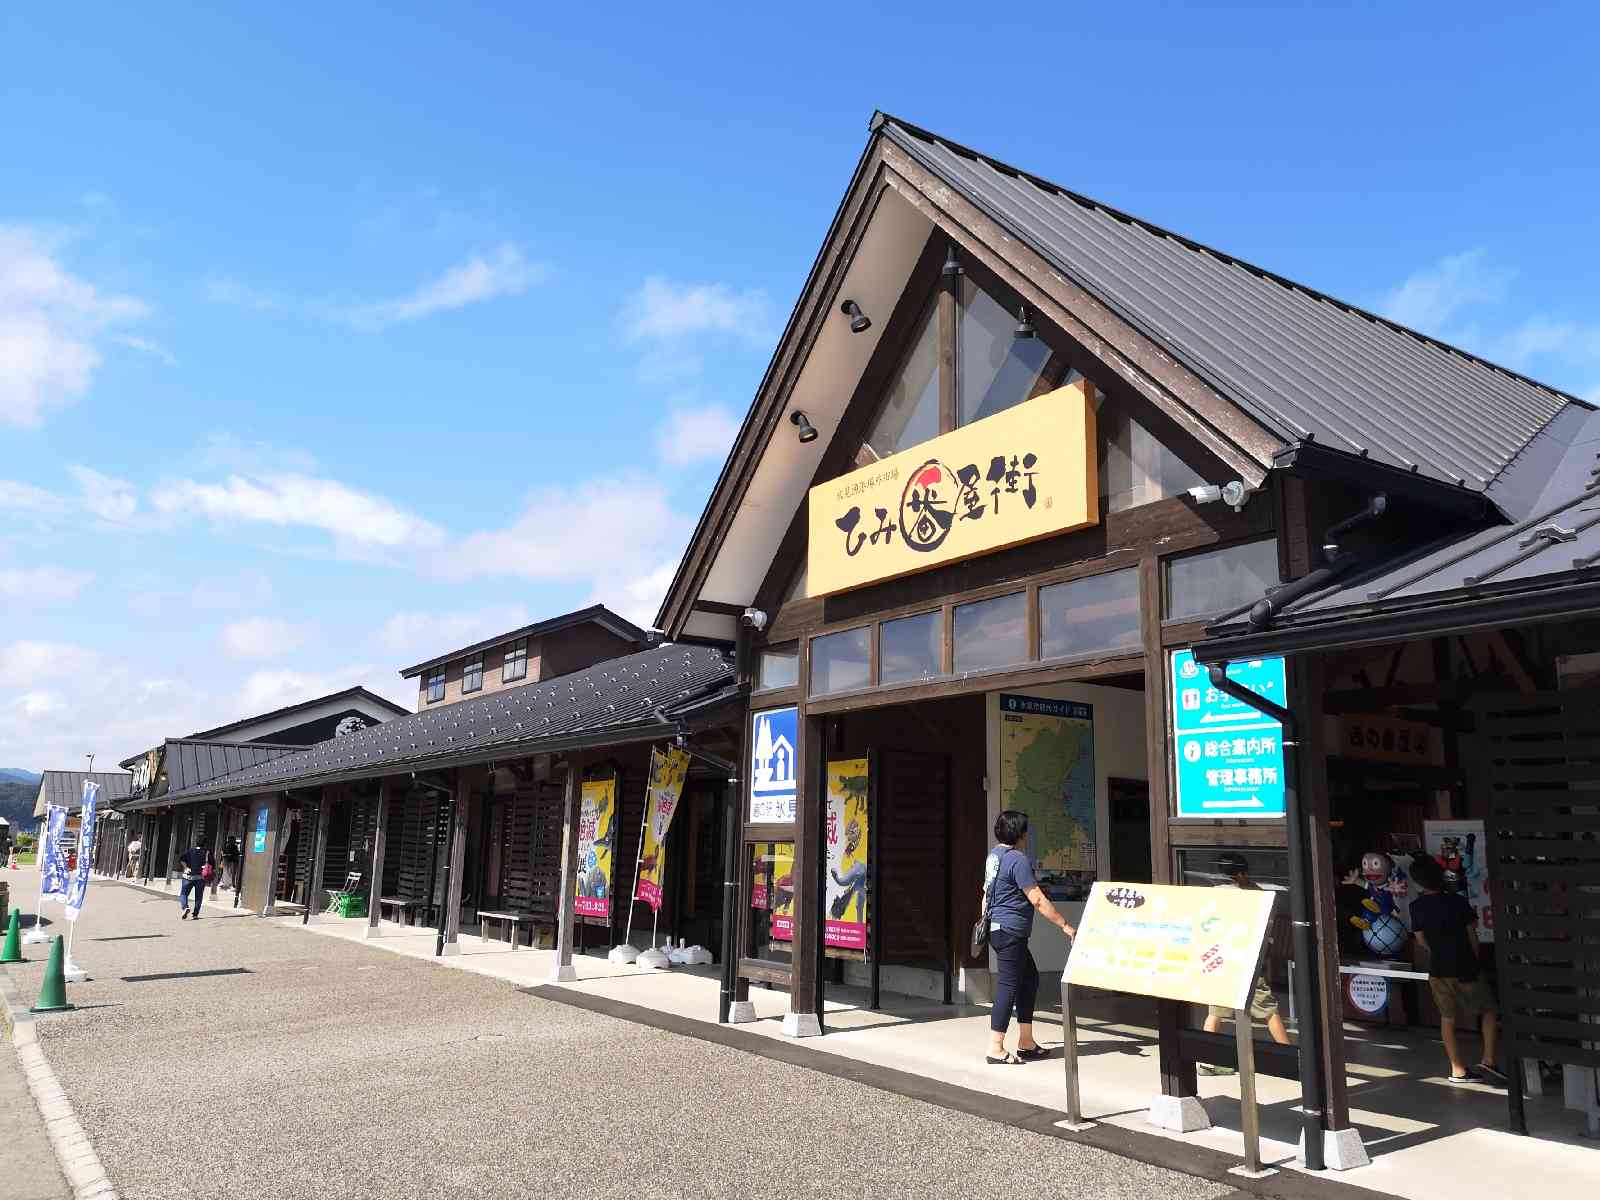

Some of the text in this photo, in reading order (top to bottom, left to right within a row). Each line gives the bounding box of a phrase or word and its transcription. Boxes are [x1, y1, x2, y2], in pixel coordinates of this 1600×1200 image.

[1204, 737, 1276, 758] 総合案内所
[1205, 768, 1278, 787] 管理事務所
